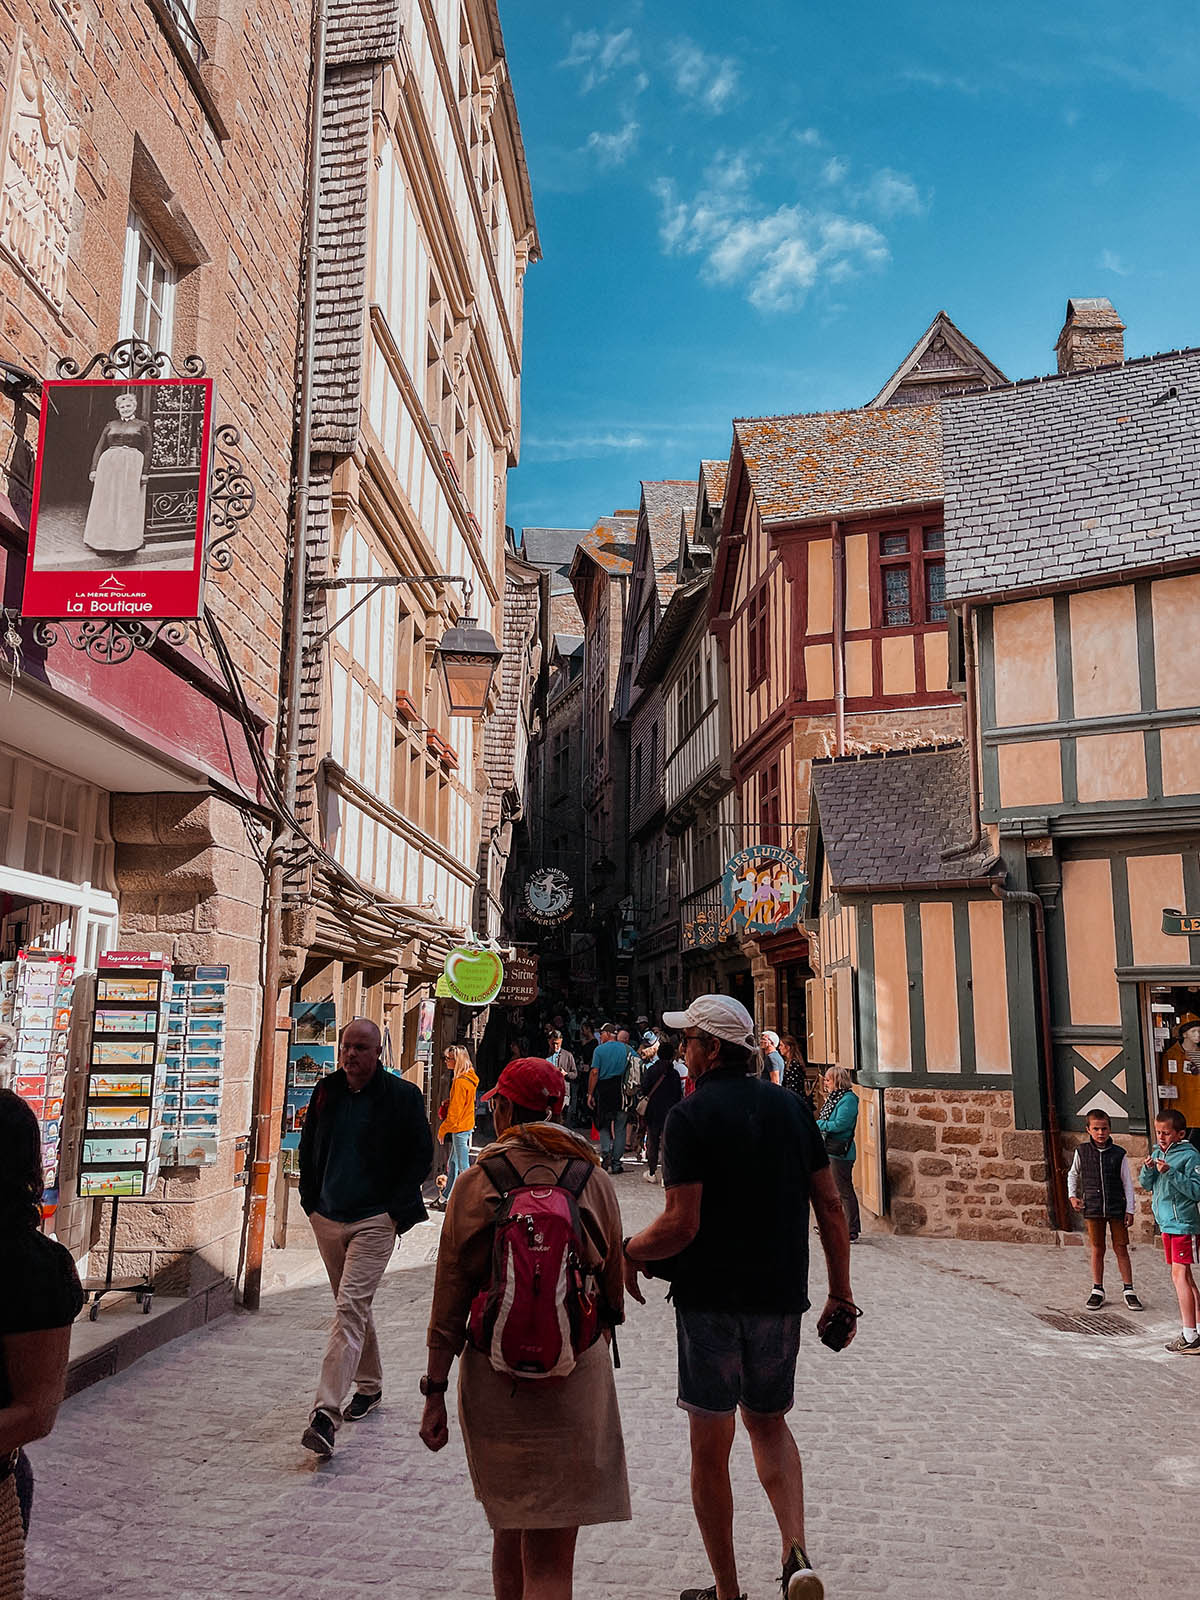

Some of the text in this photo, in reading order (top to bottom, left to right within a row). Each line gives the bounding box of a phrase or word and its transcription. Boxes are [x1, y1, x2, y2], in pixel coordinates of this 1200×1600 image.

[66, 600, 153, 614] La Boutique
[728, 847, 799, 873] LES LUTINS
